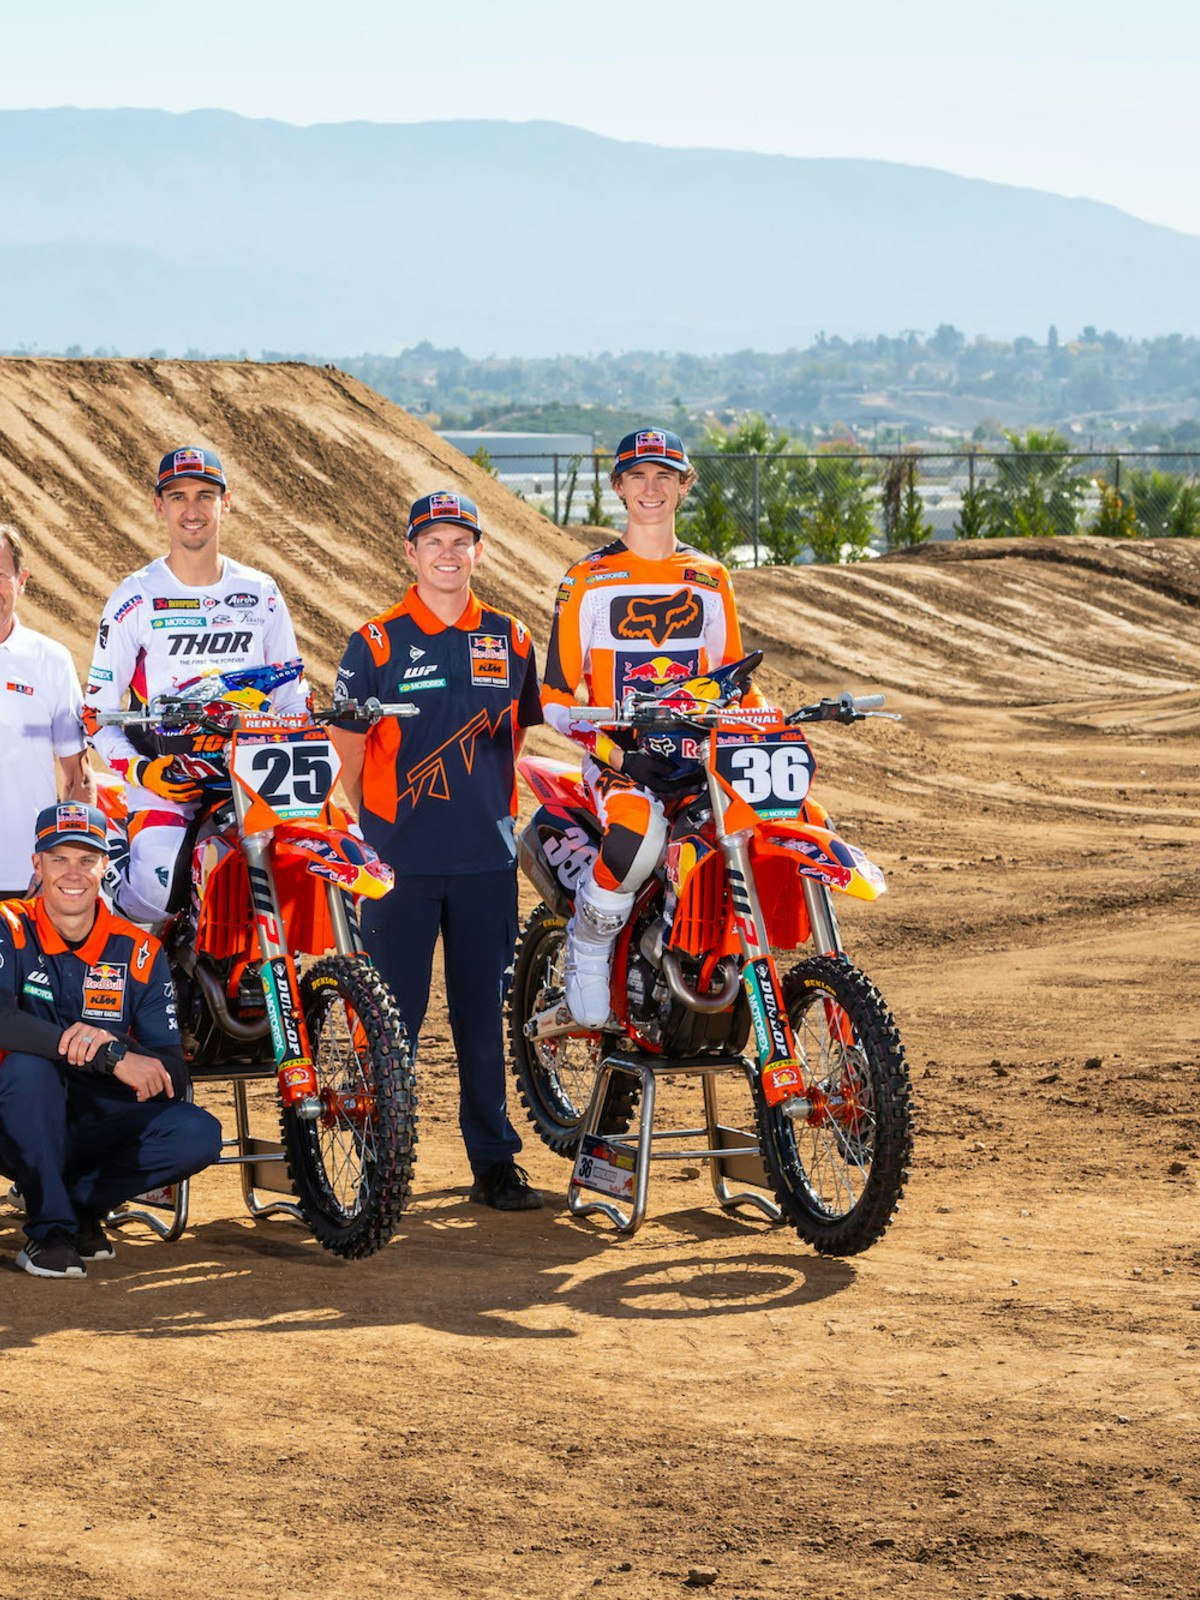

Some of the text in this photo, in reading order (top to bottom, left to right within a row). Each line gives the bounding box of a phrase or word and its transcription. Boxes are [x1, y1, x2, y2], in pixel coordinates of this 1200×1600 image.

[165, 617, 203, 626] MOTOREX
[167, 631, 253, 656] THOR
[478, 662, 502, 673] KTM
[411, 679, 445, 690] MOTOREX
[252, 745, 332, 806] 25
[731, 747, 810, 804] 36
[543, 826, 599, 891] 36
[86, 976, 123, 990] Red Bull
[311, 977, 339, 990] DUNLOP
[90, 994, 116, 1005] KTM
[265, 994, 284, 1053] MOTOREX
[748, 994, 770, 1053] MOTOREX
[579, 1157, 593, 1178] 36
